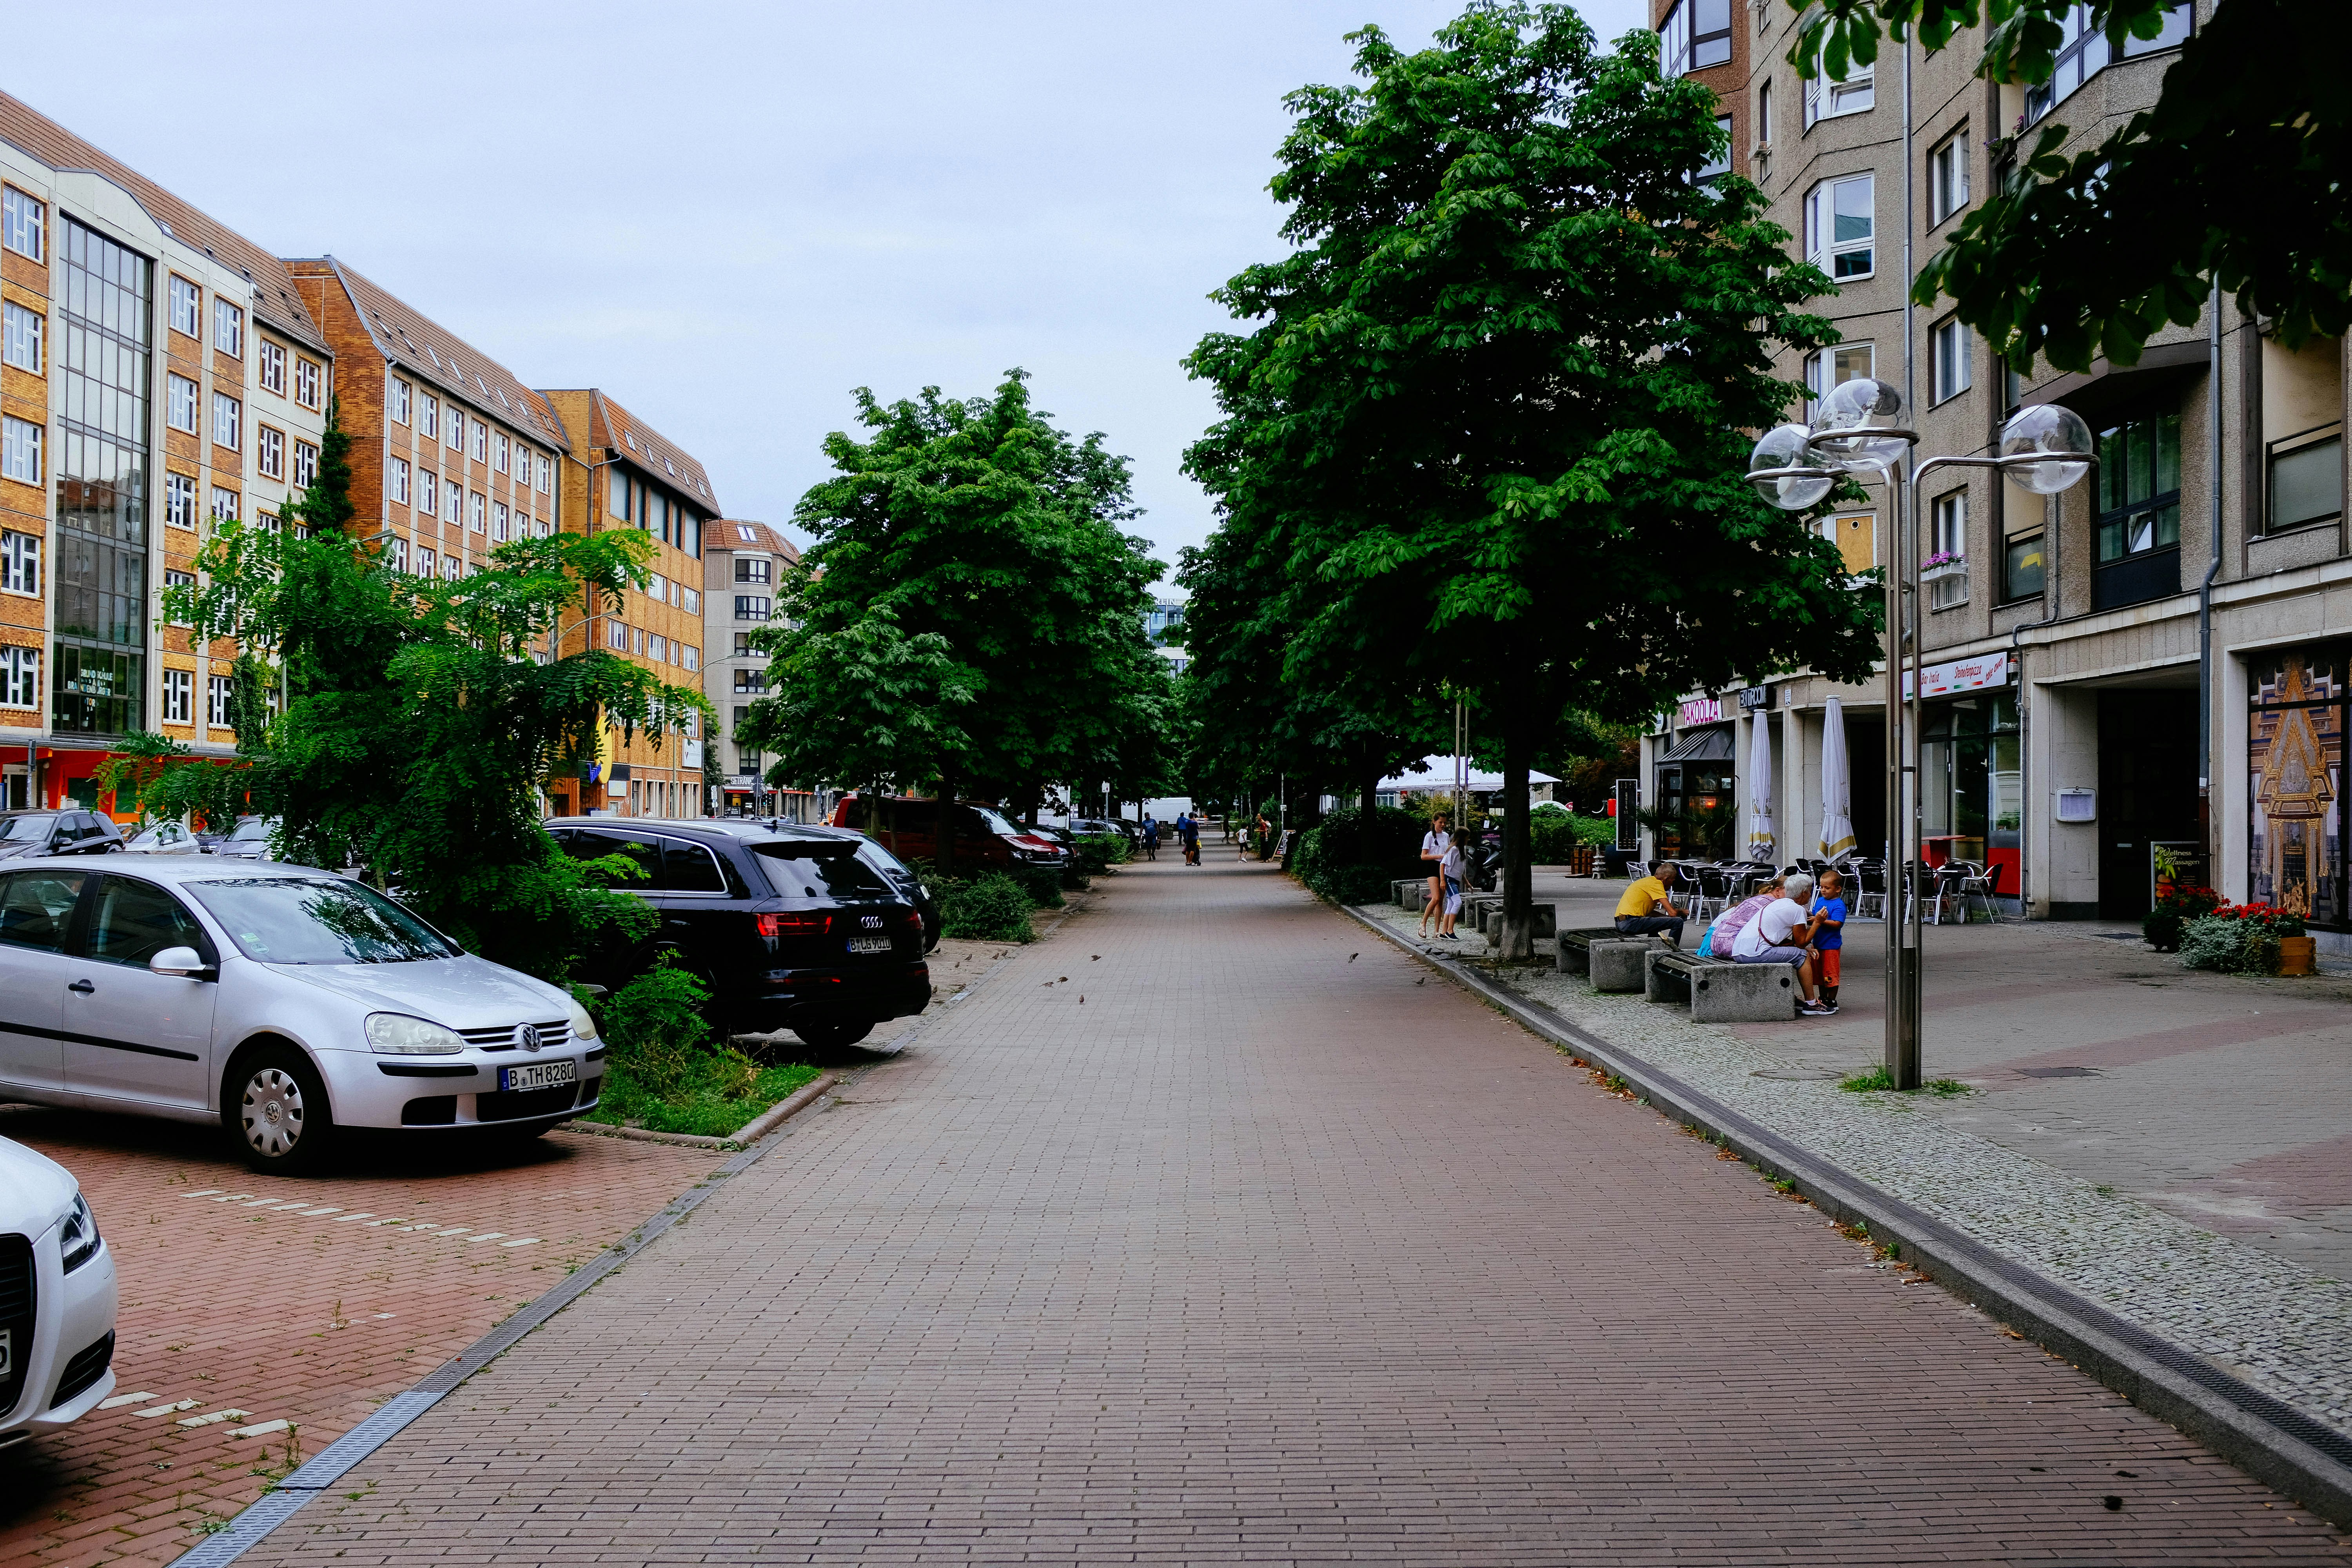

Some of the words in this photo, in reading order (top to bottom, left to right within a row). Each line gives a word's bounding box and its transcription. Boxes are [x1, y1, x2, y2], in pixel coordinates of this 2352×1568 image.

[1954, 662, 1982, 679] Steinofenpizza
[1994, 656, 2004, 673] away
[1929, 670, 1940, 683] Italia
[1683, 699, 1719, 725] YAKOOLZA
[2157, 847, 2192, 856] Wellness
[2164, 857, 2200, 866] Massagen
[850, 938, 856, 951] B
[509, 1070, 518, 1087] B
[527, 1067, 543, 1085] TH
[546, 1063, 574, 1082] 8280
